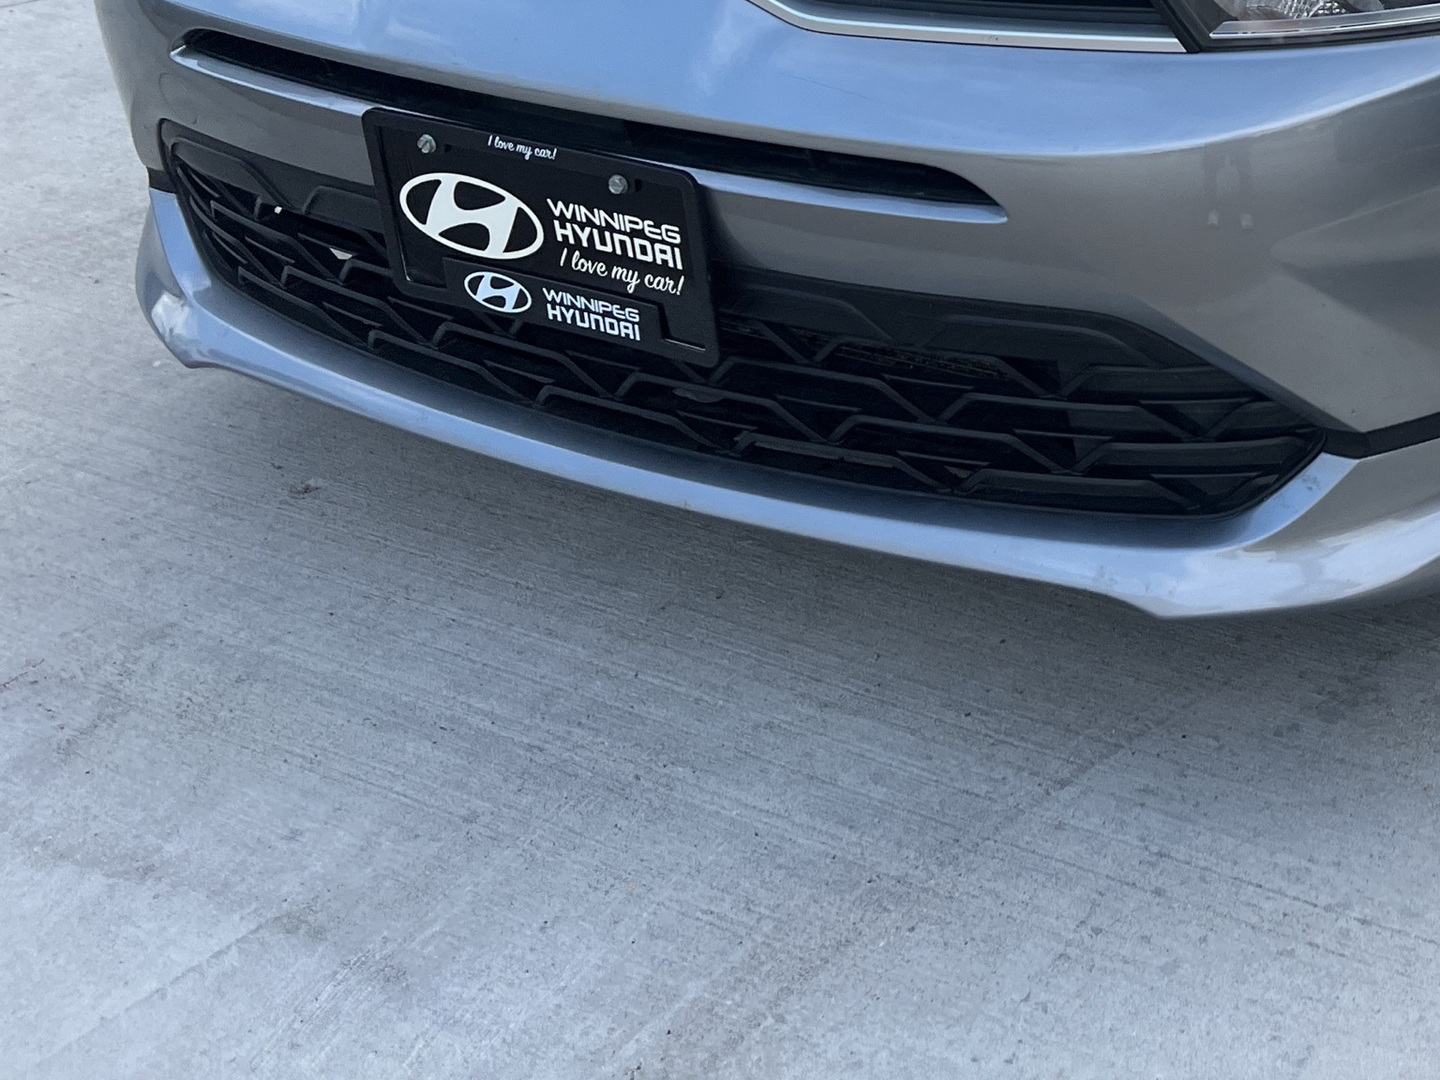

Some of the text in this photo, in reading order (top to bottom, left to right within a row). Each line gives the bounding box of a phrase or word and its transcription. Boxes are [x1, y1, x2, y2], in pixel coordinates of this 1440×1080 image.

[487, 134, 558, 161] I love my car!
[546, 198, 681, 244] WINNIPEG
[553, 219, 683, 270] HYUNDAI
[560, 247, 685, 296] I love my car!
[542, 287, 640, 323] WINNIPEG
[546, 302, 641, 341] HYUNDAI
